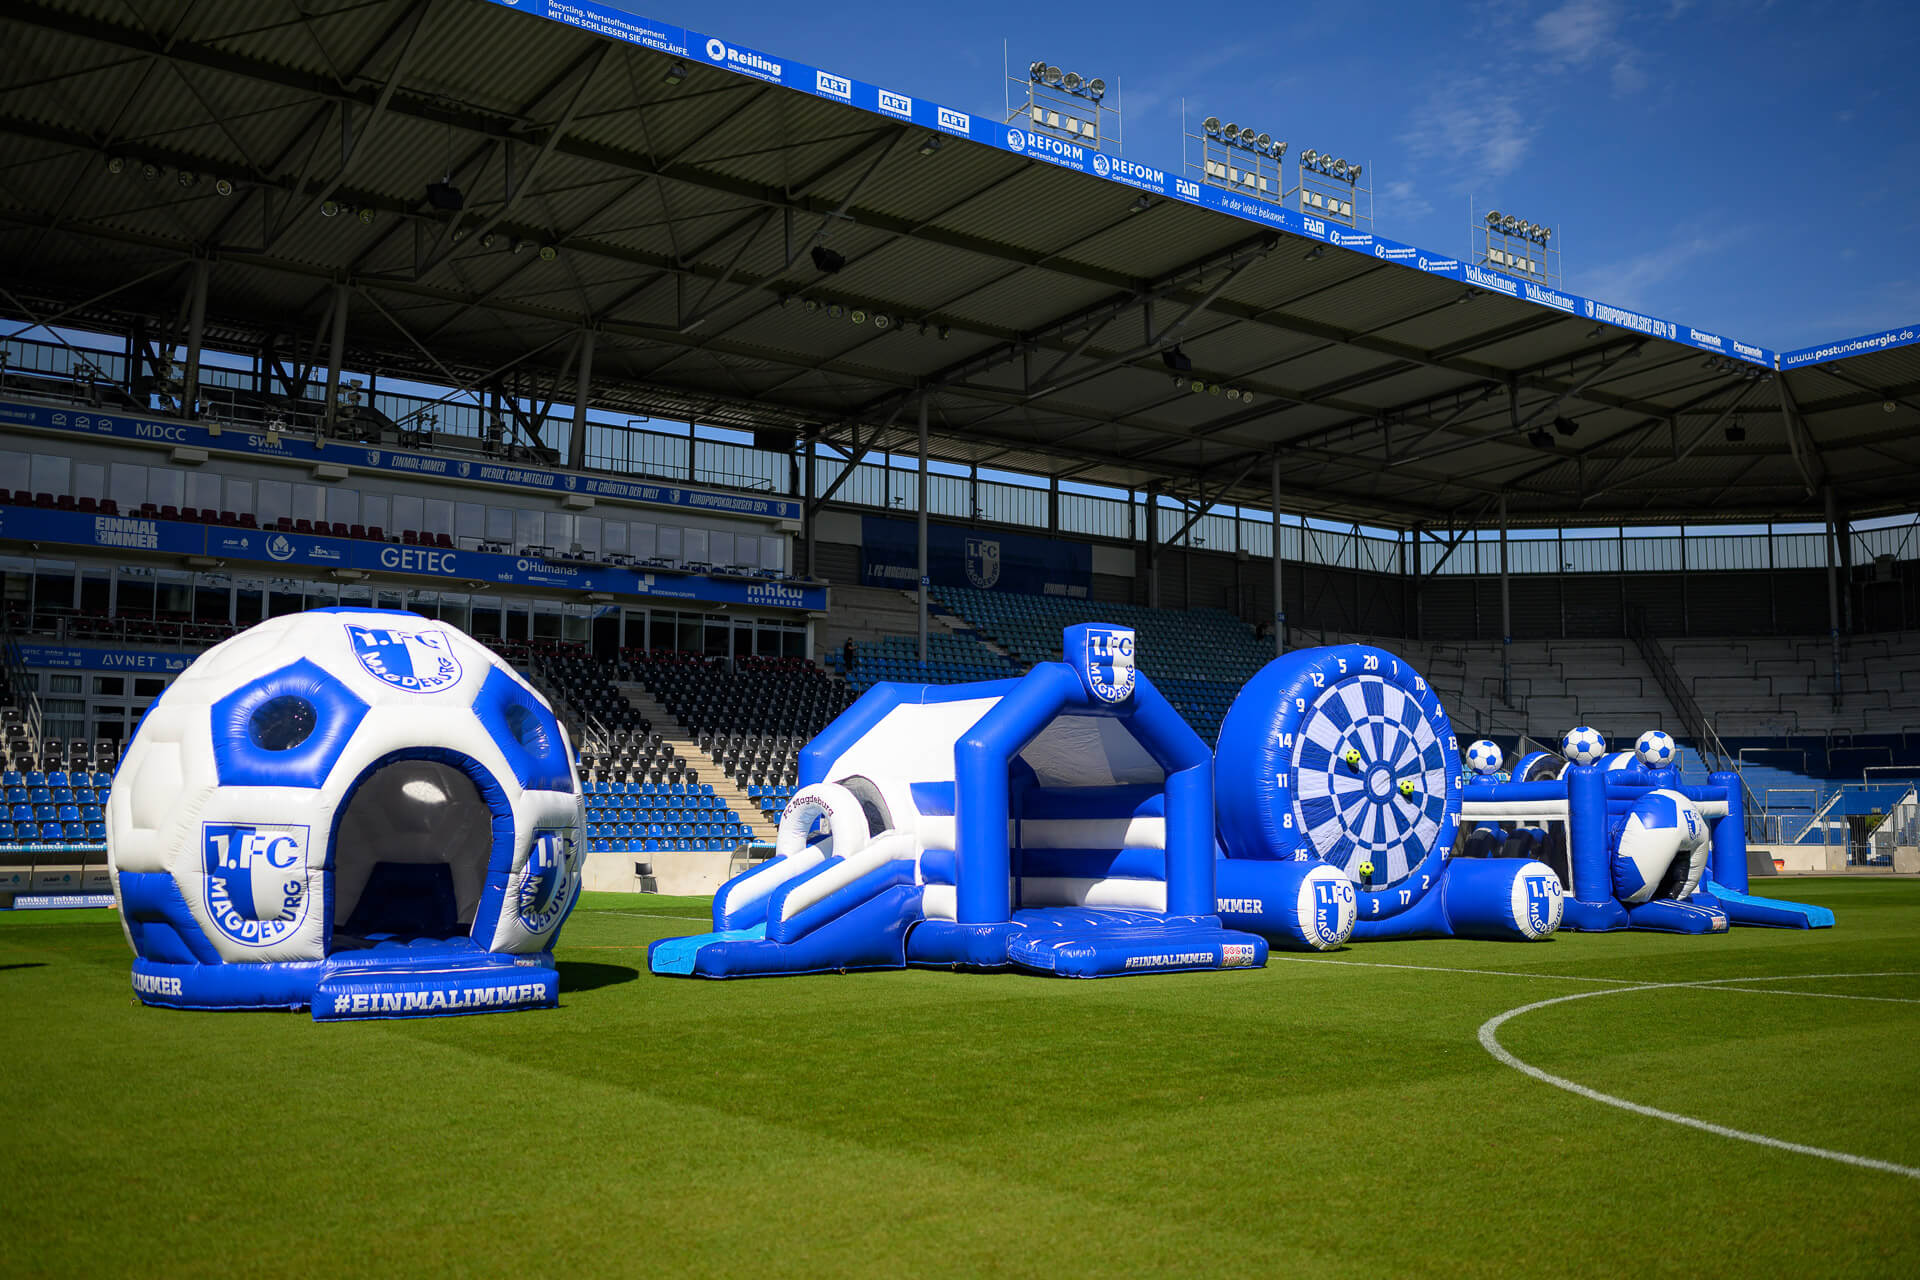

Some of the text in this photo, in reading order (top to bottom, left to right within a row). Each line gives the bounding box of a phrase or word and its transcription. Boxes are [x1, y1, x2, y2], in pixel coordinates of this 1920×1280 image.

[548, 0, 668, 41] Recycling. Wertstoffmanagement.
[548, 9, 690, 56] MIT UNS SCHLIESSEN SIE KREISLÄUFE.
[727, 48, 782, 76] Reiling
[821, 78, 847, 92] ART
[883, 96, 907, 110] ART
[942, 113, 966, 128] ART
[1027, 134, 1083, 161] REFORM
[1027, 149, 1084, 171] Gartenstadt seit 1909
[1112, 158, 1164, 184] REFORM
[1112, 173, 1165, 193] Gartenstadt seit 1909
[1176, 179, 1200, 198] FAM
[1221, 195, 1229, 208] in
[1229, 199, 1242, 211] der
[1242, 202, 1258, 216] Welt
[1258, 206, 1285, 224] bekannt
[1303, 217, 1325, 236] FAM
[1464, 264, 1517, 293] Volksstimme
[1525, 282, 1575, 310] Volksstimme
[1595, 303, 1668, 337] EUROPAPOKALSIEG 1974
[1786, 329, 1914, 364] www.postundenergie.de
[135, 422, 187, 442] MDCC
[391, 455, 447, 473] EINMAL-IMMER
[480, 465, 555, 487] WERDE FCM-MITGLIED
[585, 479, 597, 492] DIE
[629, 484, 643, 498] DER
[642, 487, 660, 500] WELT
[753, 500, 769, 513] 1974
[95, 516, 159, 536] EINMAL
[381, 547, 456, 574] GETEC
[529, 561, 579, 576] Humanas
[747, 583, 804, 600] mhkw
[747, 596, 803, 608] ROTHENSEE
[354, 628, 442, 650] 1.FC
[1090, 635, 1133, 657] 1.FC
[102, 654, 159, 668] AVNET
[361, 651, 456, 689] MAGDEBURG
[1338, 659, 1347, 673] 5
[1363, 655, 1378, 670] 20
[1392, 660, 1398, 675] 1
[1090, 662, 1135, 700] MAGDEBURG
[1310, 672, 1325, 688] 12
[1414, 676, 1426, 691] 18
[1296, 698, 1305, 712] 9
[1435, 704, 1443, 718] 4
[1277, 733, 1293, 748] 14
[1448, 736, 1458, 750] 13
[1276, 773, 1288, 788] 11
[1455, 776, 1462, 789] 6
[793, 794, 834, 817] Magdeburg
[1283, 813, 1292, 828] 8
[1450, 813, 1461, 827] 10
[209, 833, 300, 870] 1.FC
[1294, 848, 1308, 862] 16
[1440, 847, 1450, 861] 15
[1422, 875, 1430, 890] 2
[1527, 880, 1561, 898] 1.FC
[53, 895, 84, 903] mhkw
[1317, 885, 1353, 904] 1.FC
[1399, 890, 1412, 905] 17
[211, 876, 302, 939] MAGDEBURG
[1217, 898, 1263, 914] MMER
[1371, 899, 1380, 913] 3
[1317, 908, 1355, 942] MAGDEBURG
[1530, 902, 1562, 932] MAGDEBURG
[1125, 951, 1214, 969] #EINMALIMMER
[333, 982, 547, 1014] #EINMALIMMER
